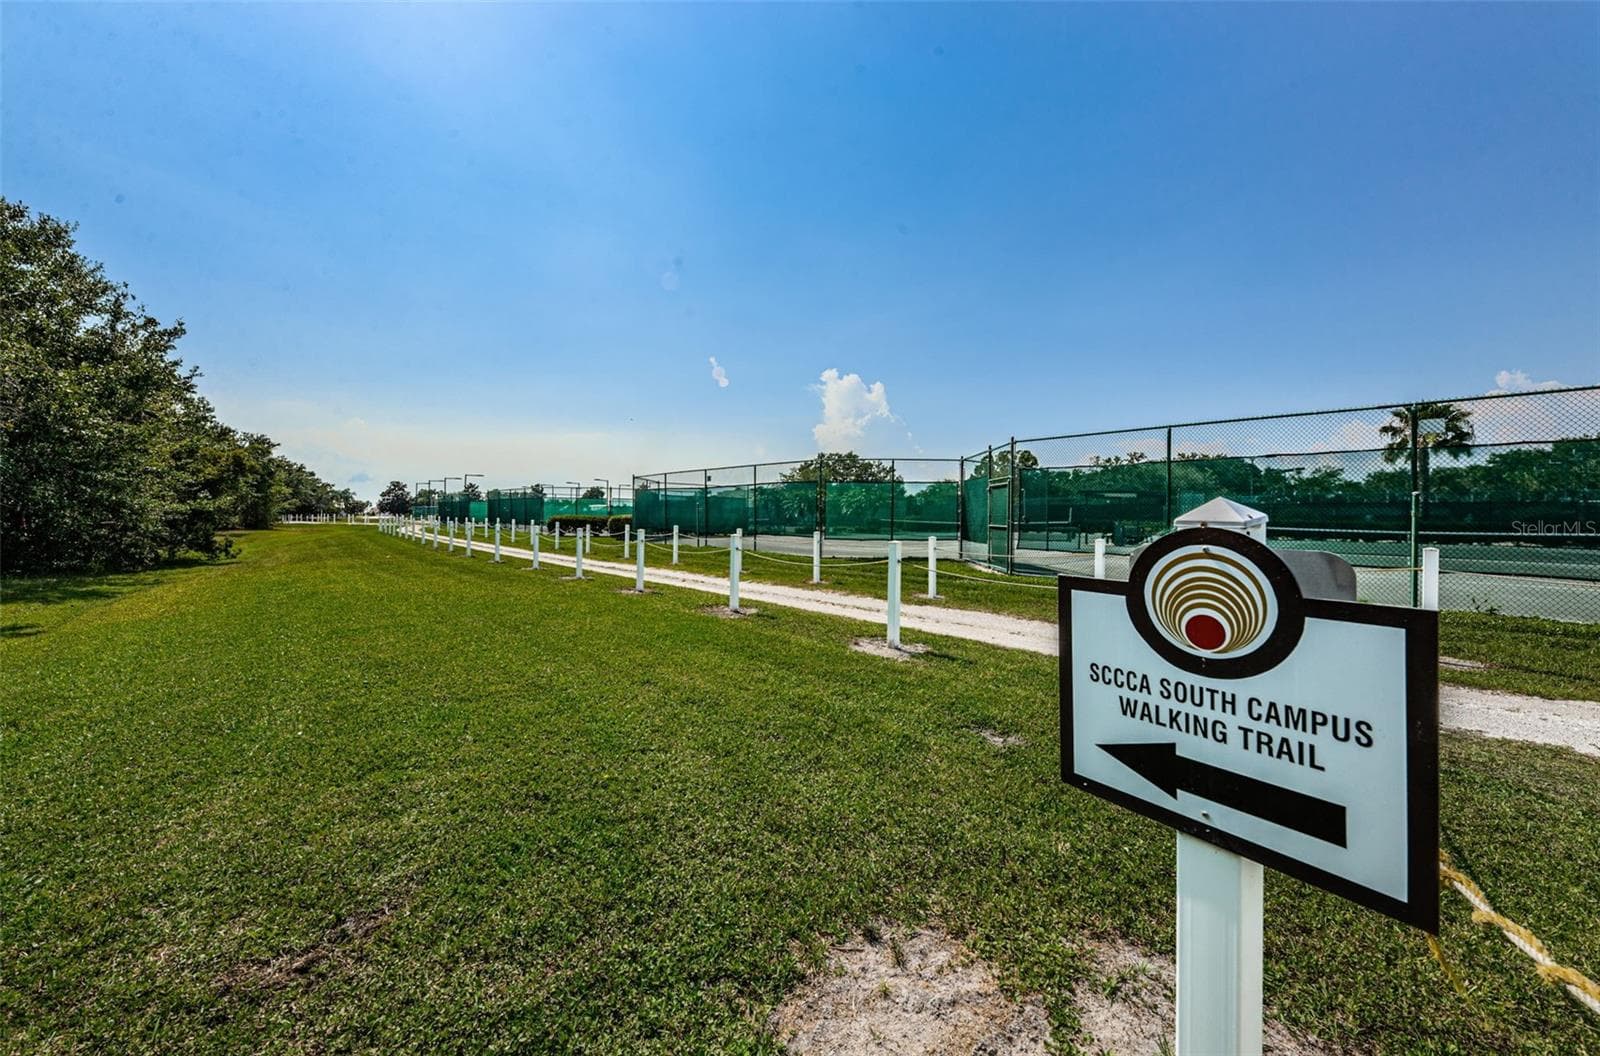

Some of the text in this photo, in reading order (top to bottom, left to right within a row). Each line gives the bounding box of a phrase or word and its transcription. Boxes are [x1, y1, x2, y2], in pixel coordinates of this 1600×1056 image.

[1089, 662, 1375, 749] SCCCA SOUTH CAMPUS
[1118, 695, 1327, 773] WALKING TRAIL
